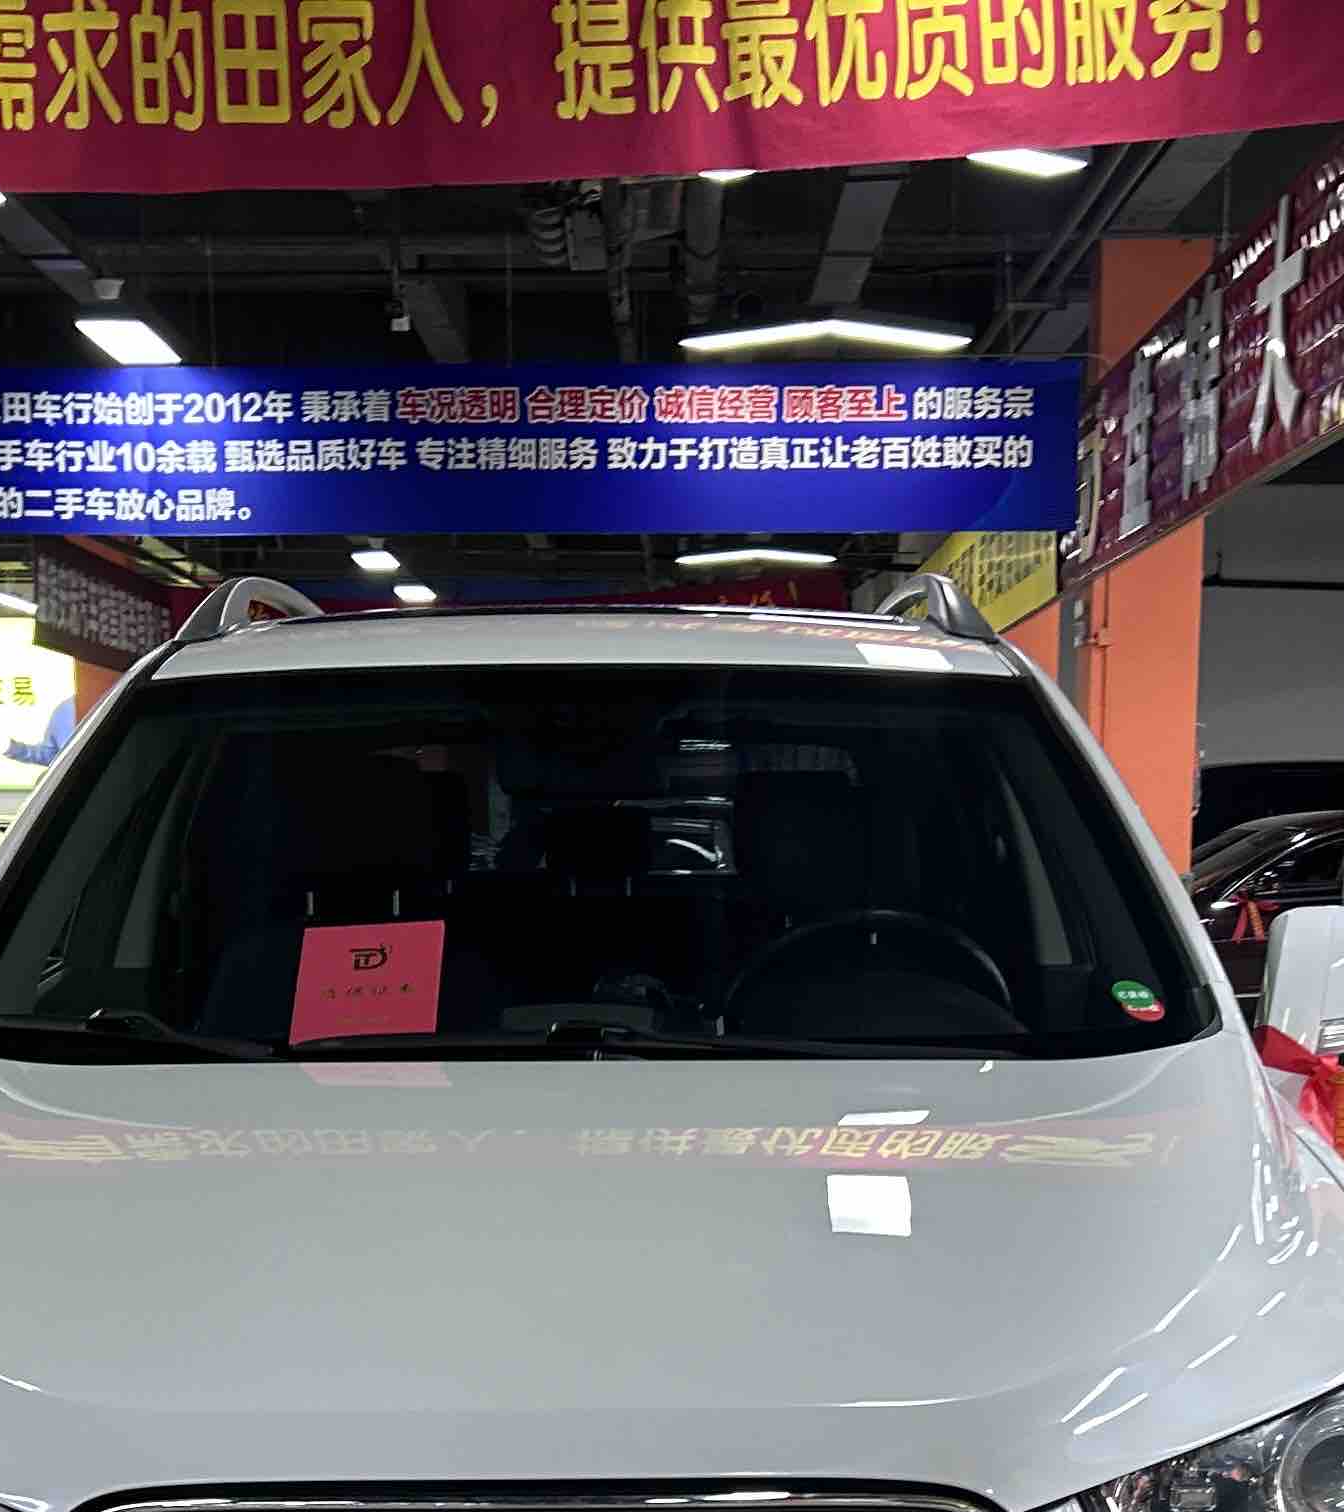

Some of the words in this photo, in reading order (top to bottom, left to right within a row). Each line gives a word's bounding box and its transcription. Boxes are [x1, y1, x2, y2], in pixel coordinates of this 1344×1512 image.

[301, 390, 393, 423] 秉承着
[397, 386, 519, 424] 车况透明
[526, 385, 649, 423] 合理定价
[654, 385, 778, 422] 诚信经营
[782, 384, 905, 422] 顾客至上
[913, 386, 1035, 421] 的服务宗
[223, 437, 407, 472] 甄选品质好车
[416, 436, 599, 470] 专注精细服务
[607, 435, 1034, 470] 致力于打造真正让老百姓敢买的
